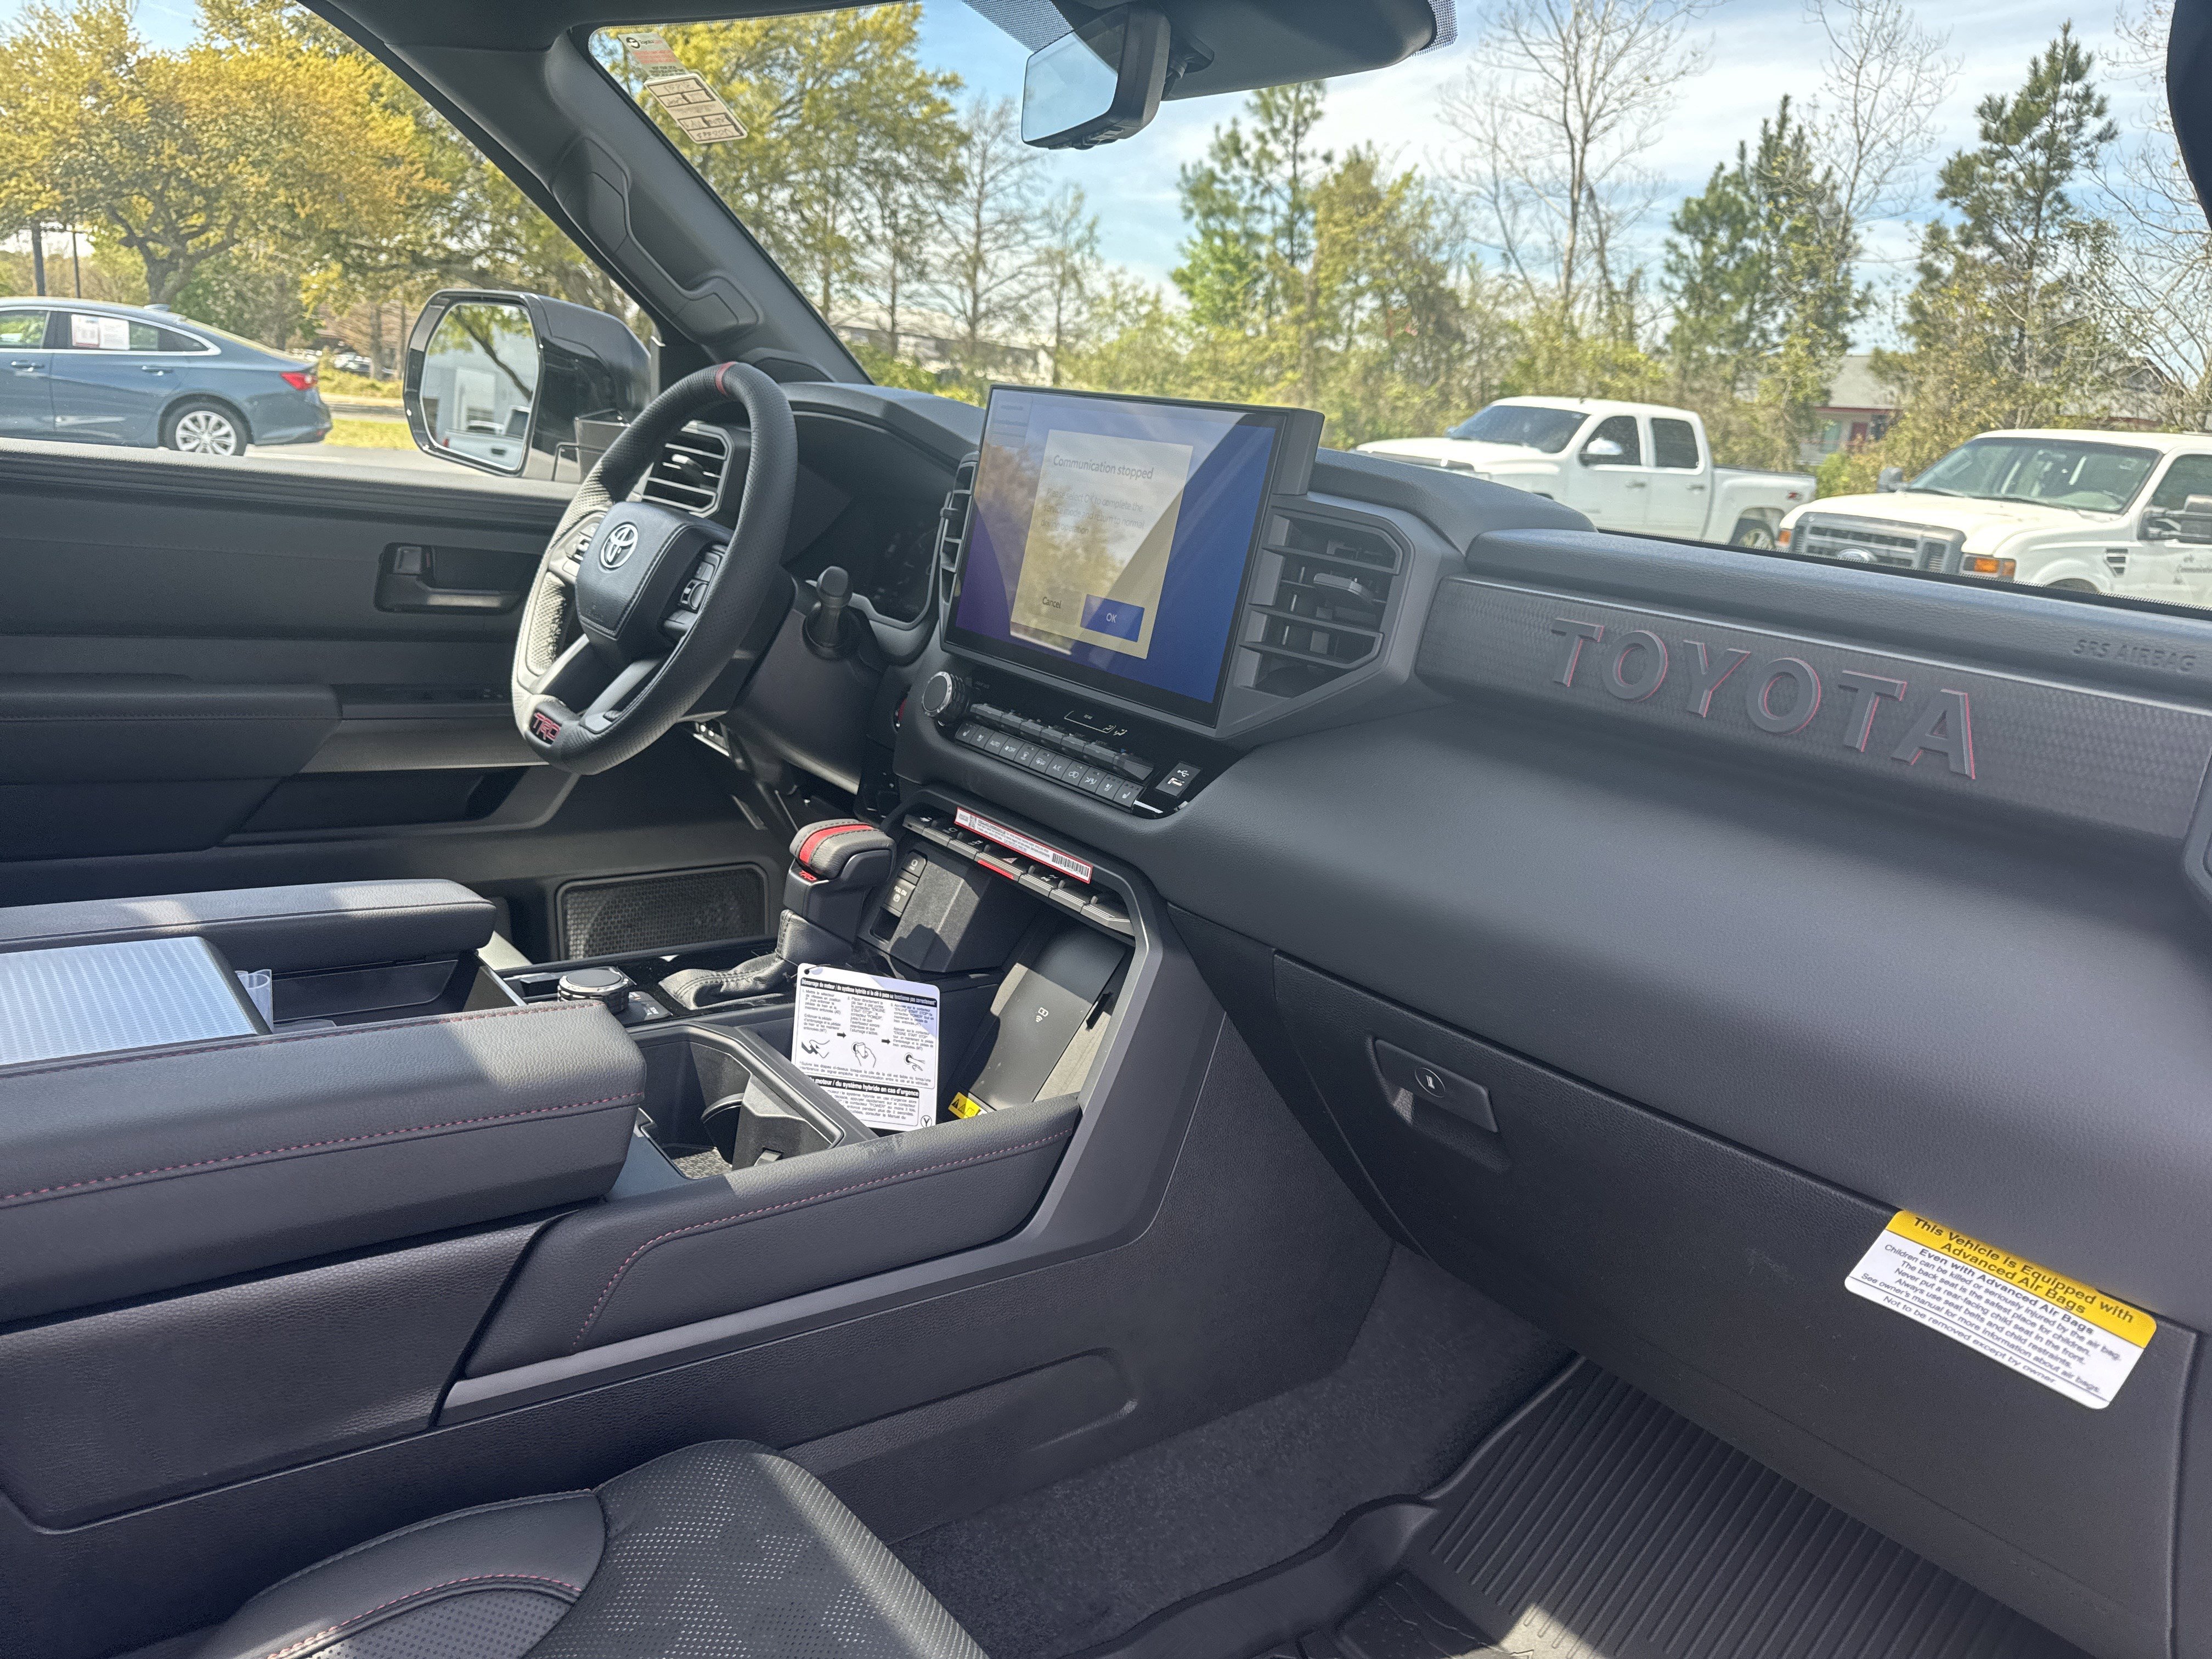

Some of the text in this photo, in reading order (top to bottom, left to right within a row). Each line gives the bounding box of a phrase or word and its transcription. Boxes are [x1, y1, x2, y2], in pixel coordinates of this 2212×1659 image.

[1053, 455, 1154, 480] Communication stopped
[1102, 499, 1131, 510] complete
[1132, 502, 1143, 512] the
[1122, 518, 1144, 528] normal
[1042, 596, 1062, 608] Cancel
[1106, 613, 1118, 623] OK
[2117, 645, 2196, 672] AIRBAG
[533, 712, 561, 741] TRD
[1550, 618, 1975, 780] TOYOTA
[896, 1088, 918, 1096] d'urgence
[1884, 1244, 1919, 1262] Children
[1918, 1259, 1936, 1269] can
[1936, 1265, 1948, 1274] be
[1948, 1271, 1973, 1285] killed
[1983, 1287, 2024, 1311] seriously
[2023, 1306, 2057, 1327] injured
[2056, 1322, 2069, 1334] by
[2069, 1329, 2086, 1341] the
[2085, 1339, 2101, 1349] air
[2100, 1345, 2120, 1361] bag.
[1900, 1260, 2090, 1356] The back seat is the safest place for children.
[1915, 1216, 2134, 1323] This Vehicle is Equipped with
[1918, 1248, 2094, 1334] Even with Advanced Air Bags
[1939, 1243, 2086, 1313] Advanced Air Bags
[1860, 1272, 2100, 1393] See owner's manual for more information about air bags.
[1882, 1295, 2056, 1383] Not to be removed except by owner.
[1894, 1267, 1921, 1282] Never
[1918, 1279, 1936, 1289] put
[1942, 1289, 1990, 1316] rear-facing
[1989, 1312, 2013, 1327] child
[2012, 1323, 2034, 1338] seat
[2033, 1333, 2044, 1342] in
[2044, 1339, 2061, 1351] the
[2061, 1347, 2085, 1365] front.
[1894, 1278, 2071, 1369] Always use seat belts and child restraints.
